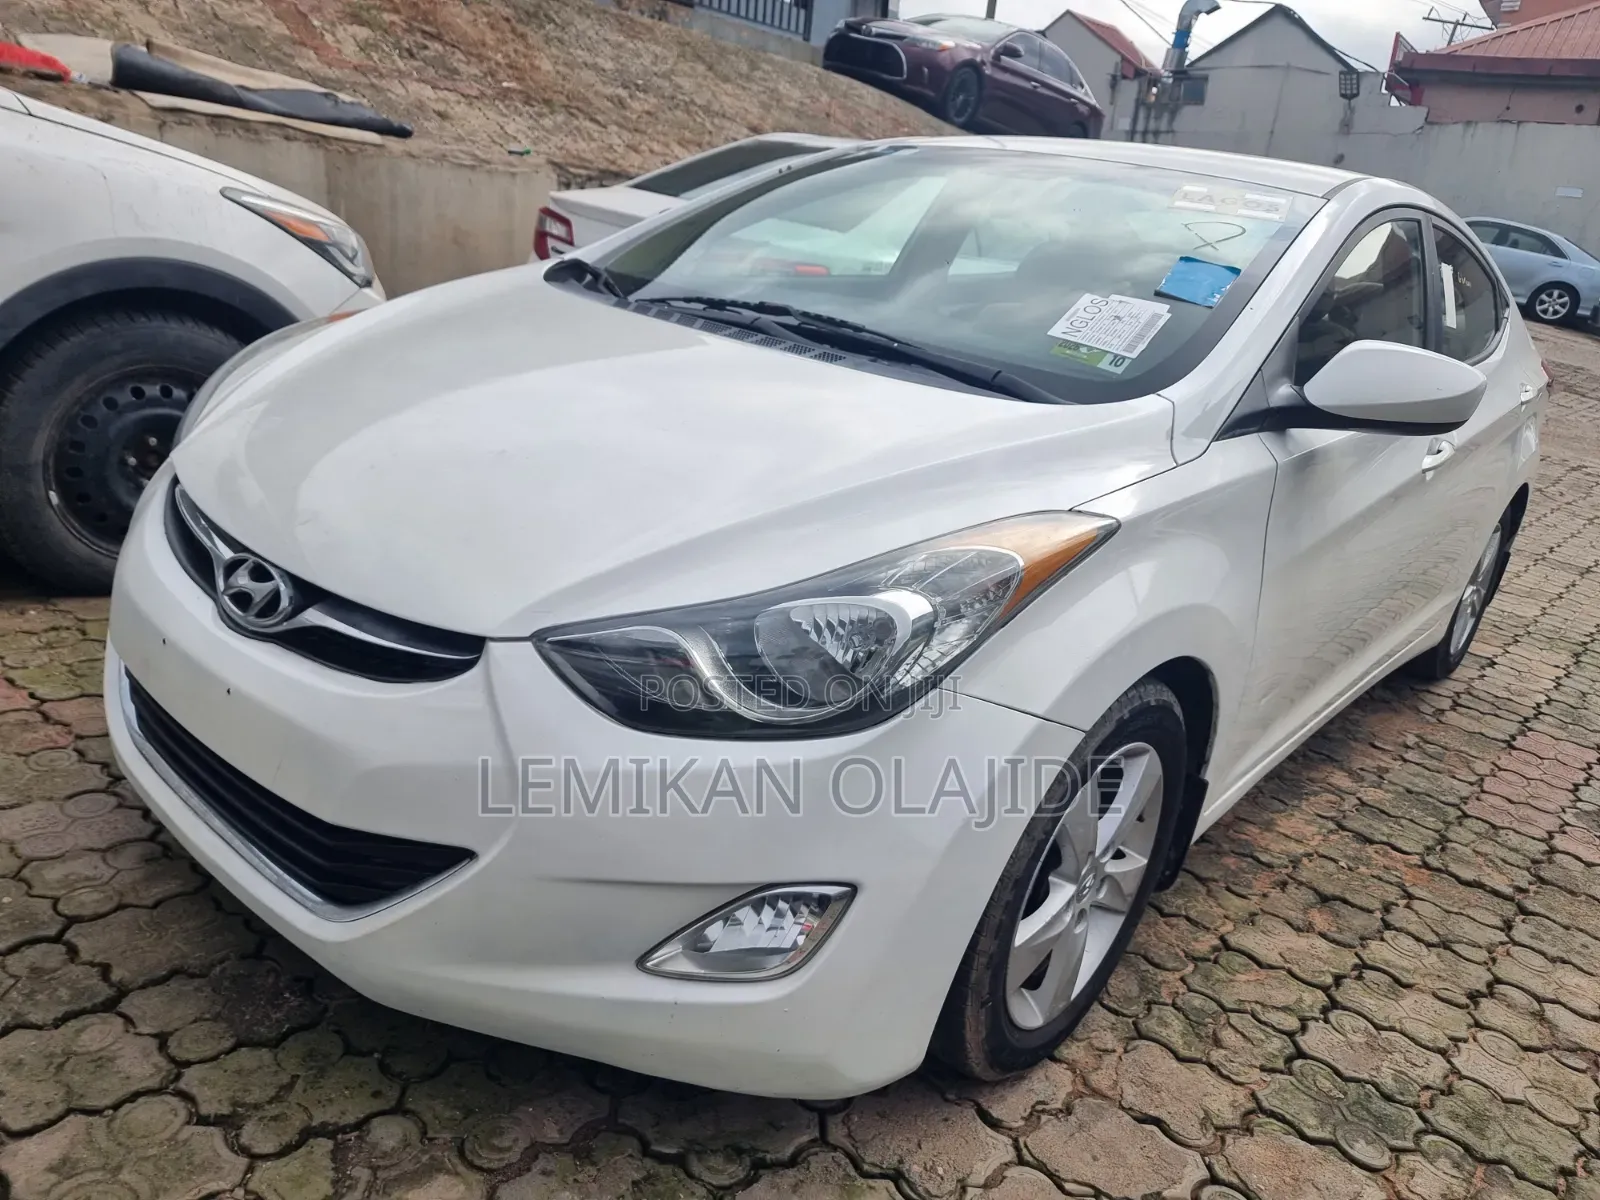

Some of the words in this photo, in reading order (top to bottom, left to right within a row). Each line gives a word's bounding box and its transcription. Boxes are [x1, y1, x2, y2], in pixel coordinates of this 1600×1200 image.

[1181, 192, 1280, 212] LAGOS
[1061, 298, 1109, 338] NGLOS
[1108, 354, 1126, 368] 10
